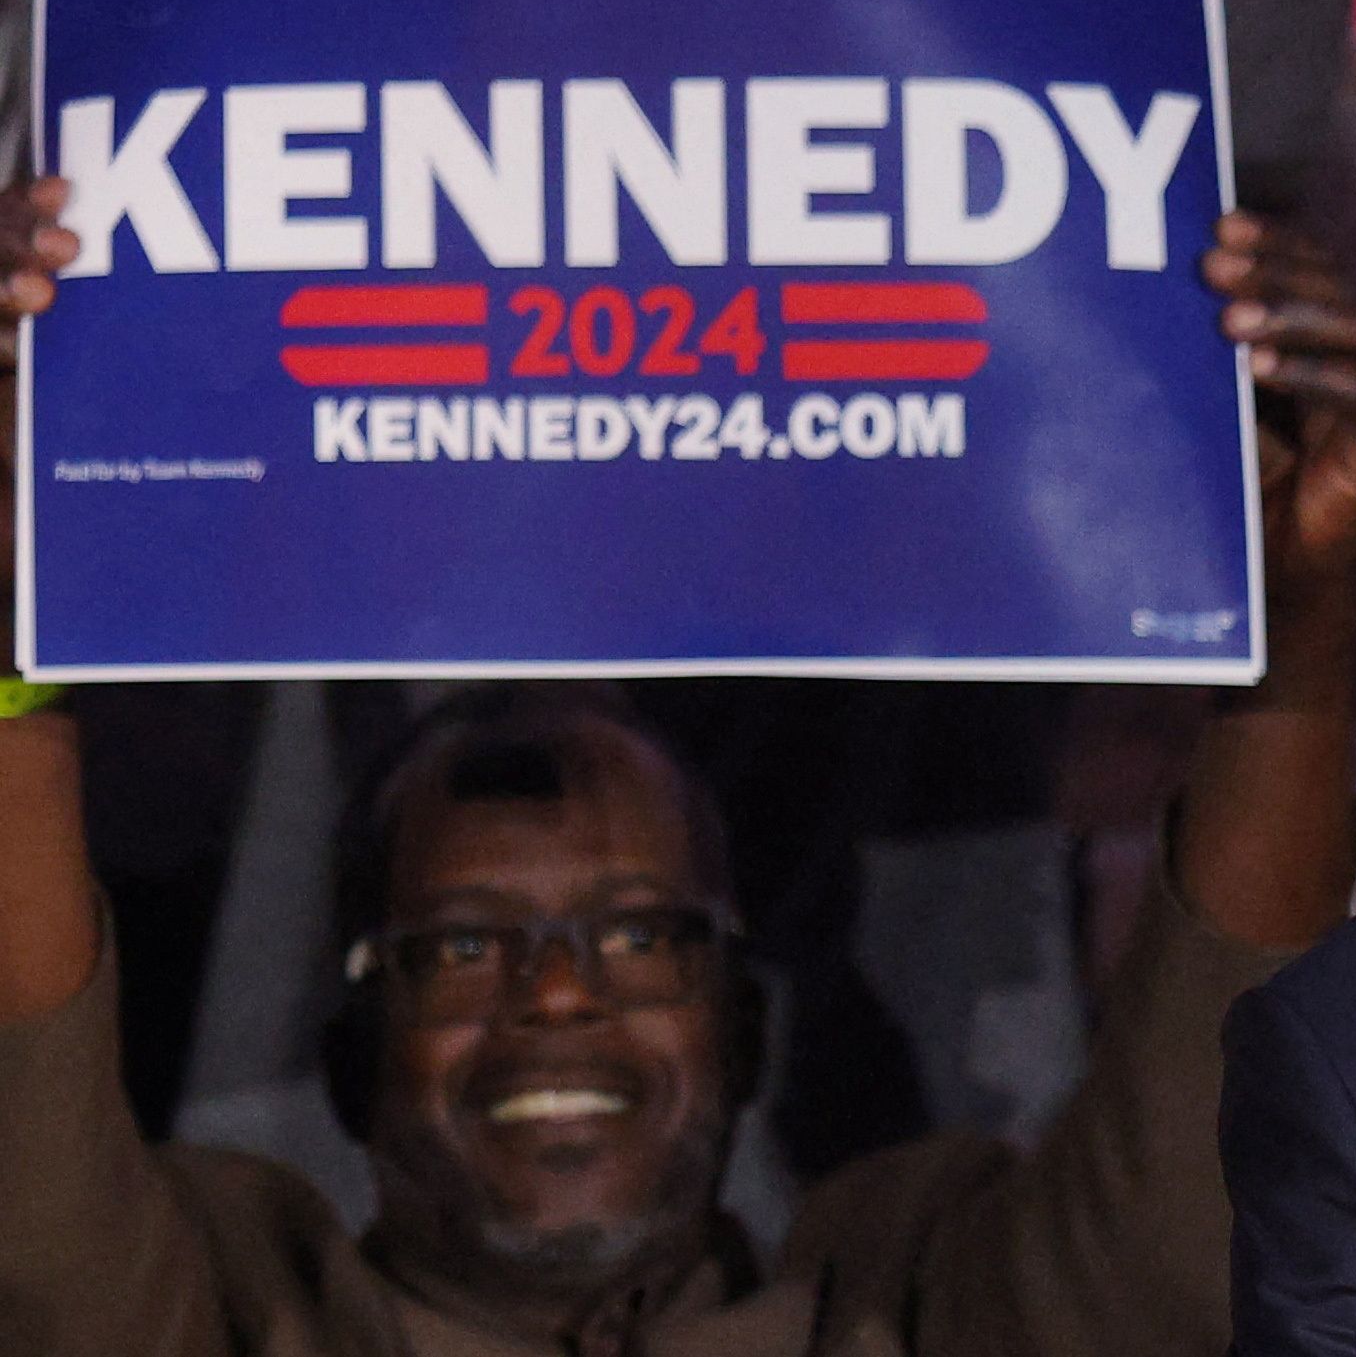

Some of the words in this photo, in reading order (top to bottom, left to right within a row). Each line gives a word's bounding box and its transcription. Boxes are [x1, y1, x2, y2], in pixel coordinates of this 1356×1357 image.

[56, 74, 1202, 280] KENNEDY
[508, 285, 765, 377] 2024
[312, 391, 967, 464] KENNEDY24.COM
